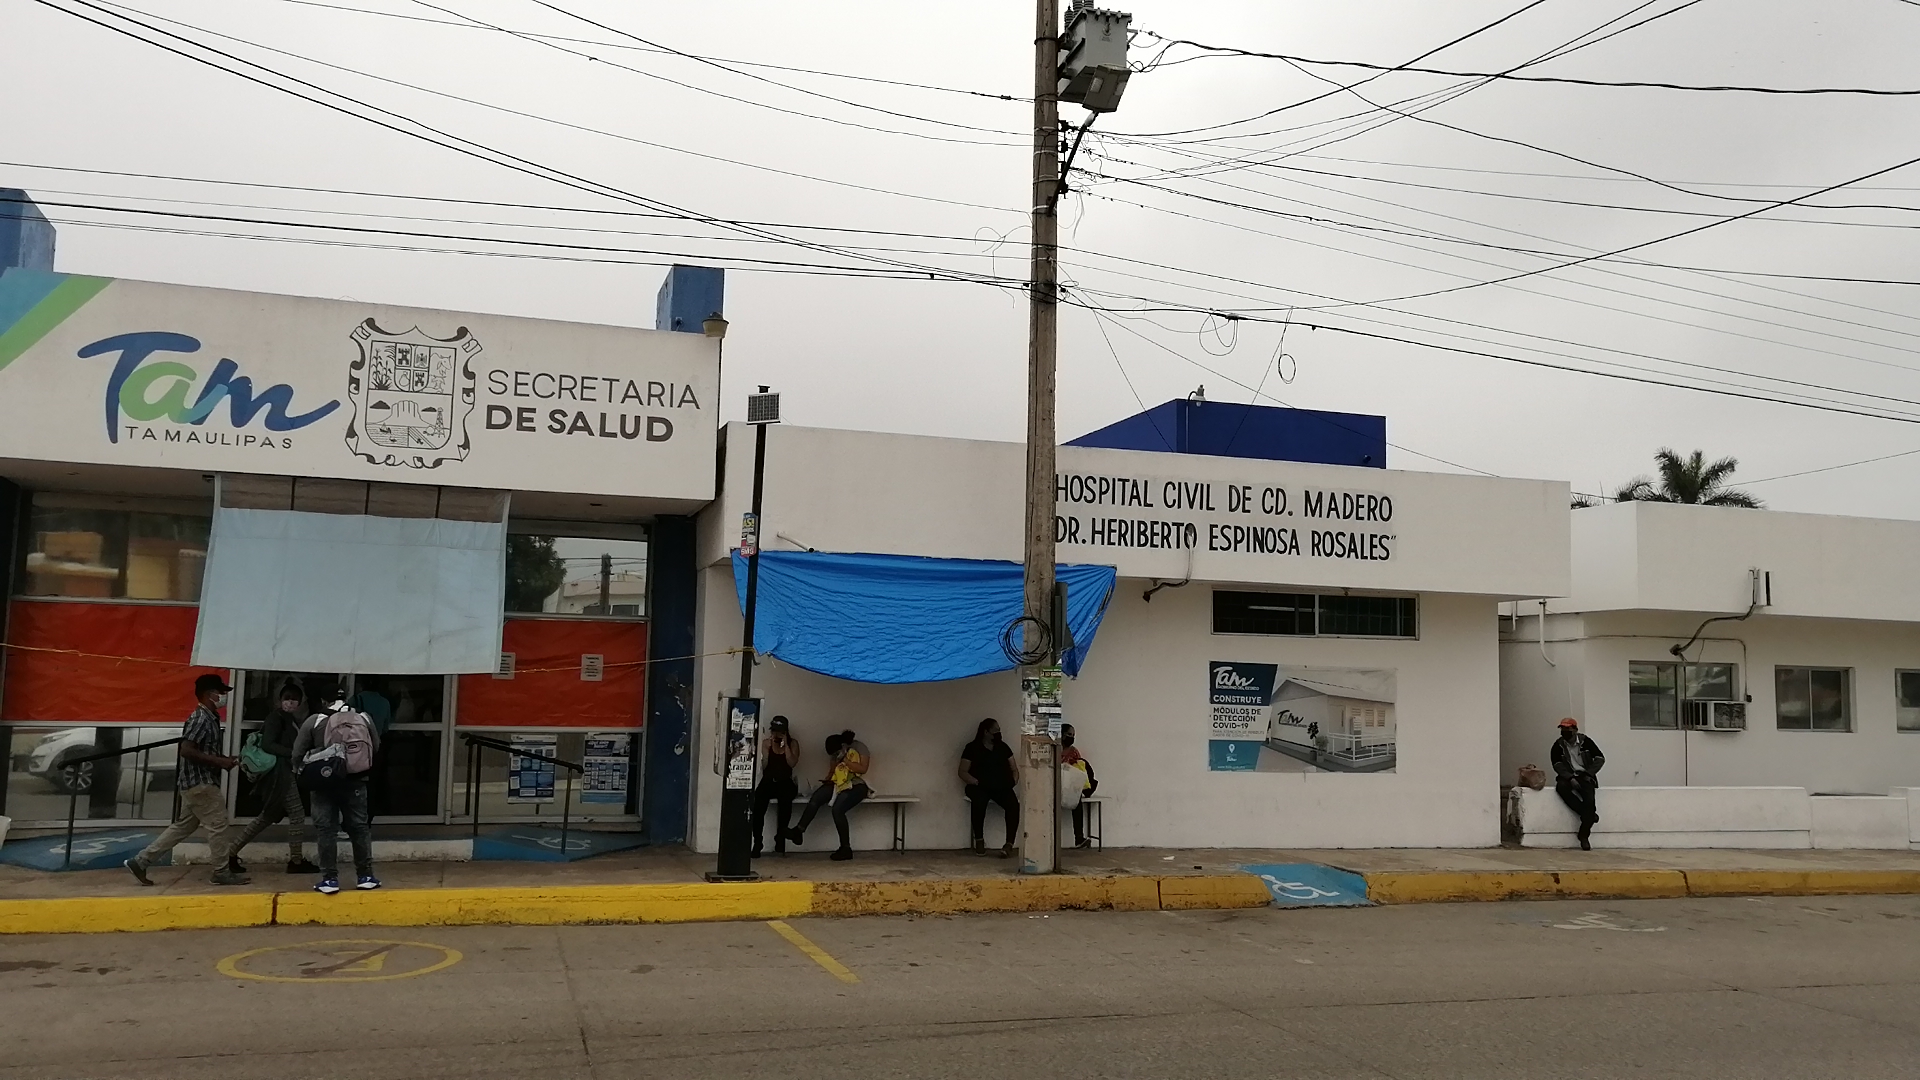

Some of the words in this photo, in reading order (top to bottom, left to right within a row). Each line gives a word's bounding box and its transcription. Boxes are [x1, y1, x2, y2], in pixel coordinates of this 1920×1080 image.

[77, 331, 341, 444] Tam
[487, 369, 701, 410] SECRETARIA
[485, 404, 537, 432] DE
[547, 408, 674, 442] SALUD
[125, 426, 293, 449] TAMAULIPAS
[1055, 473, 1154, 508] HOSPITAL
[1163, 481, 1216, 511] CIVIL
[1228, 484, 1252, 513] DE
[1261, 487, 1294, 517] CD.
[1304, 490, 1393, 522] MADERO
[1208, 523, 1301, 555] ESPINOSA
[1213, 666, 1255, 689] Tam
[1213, 694, 1262, 704] CONSTRUYE
[1251, 708, 1262, 716] DE
[1212, 722, 1249, 730] COVID-19
